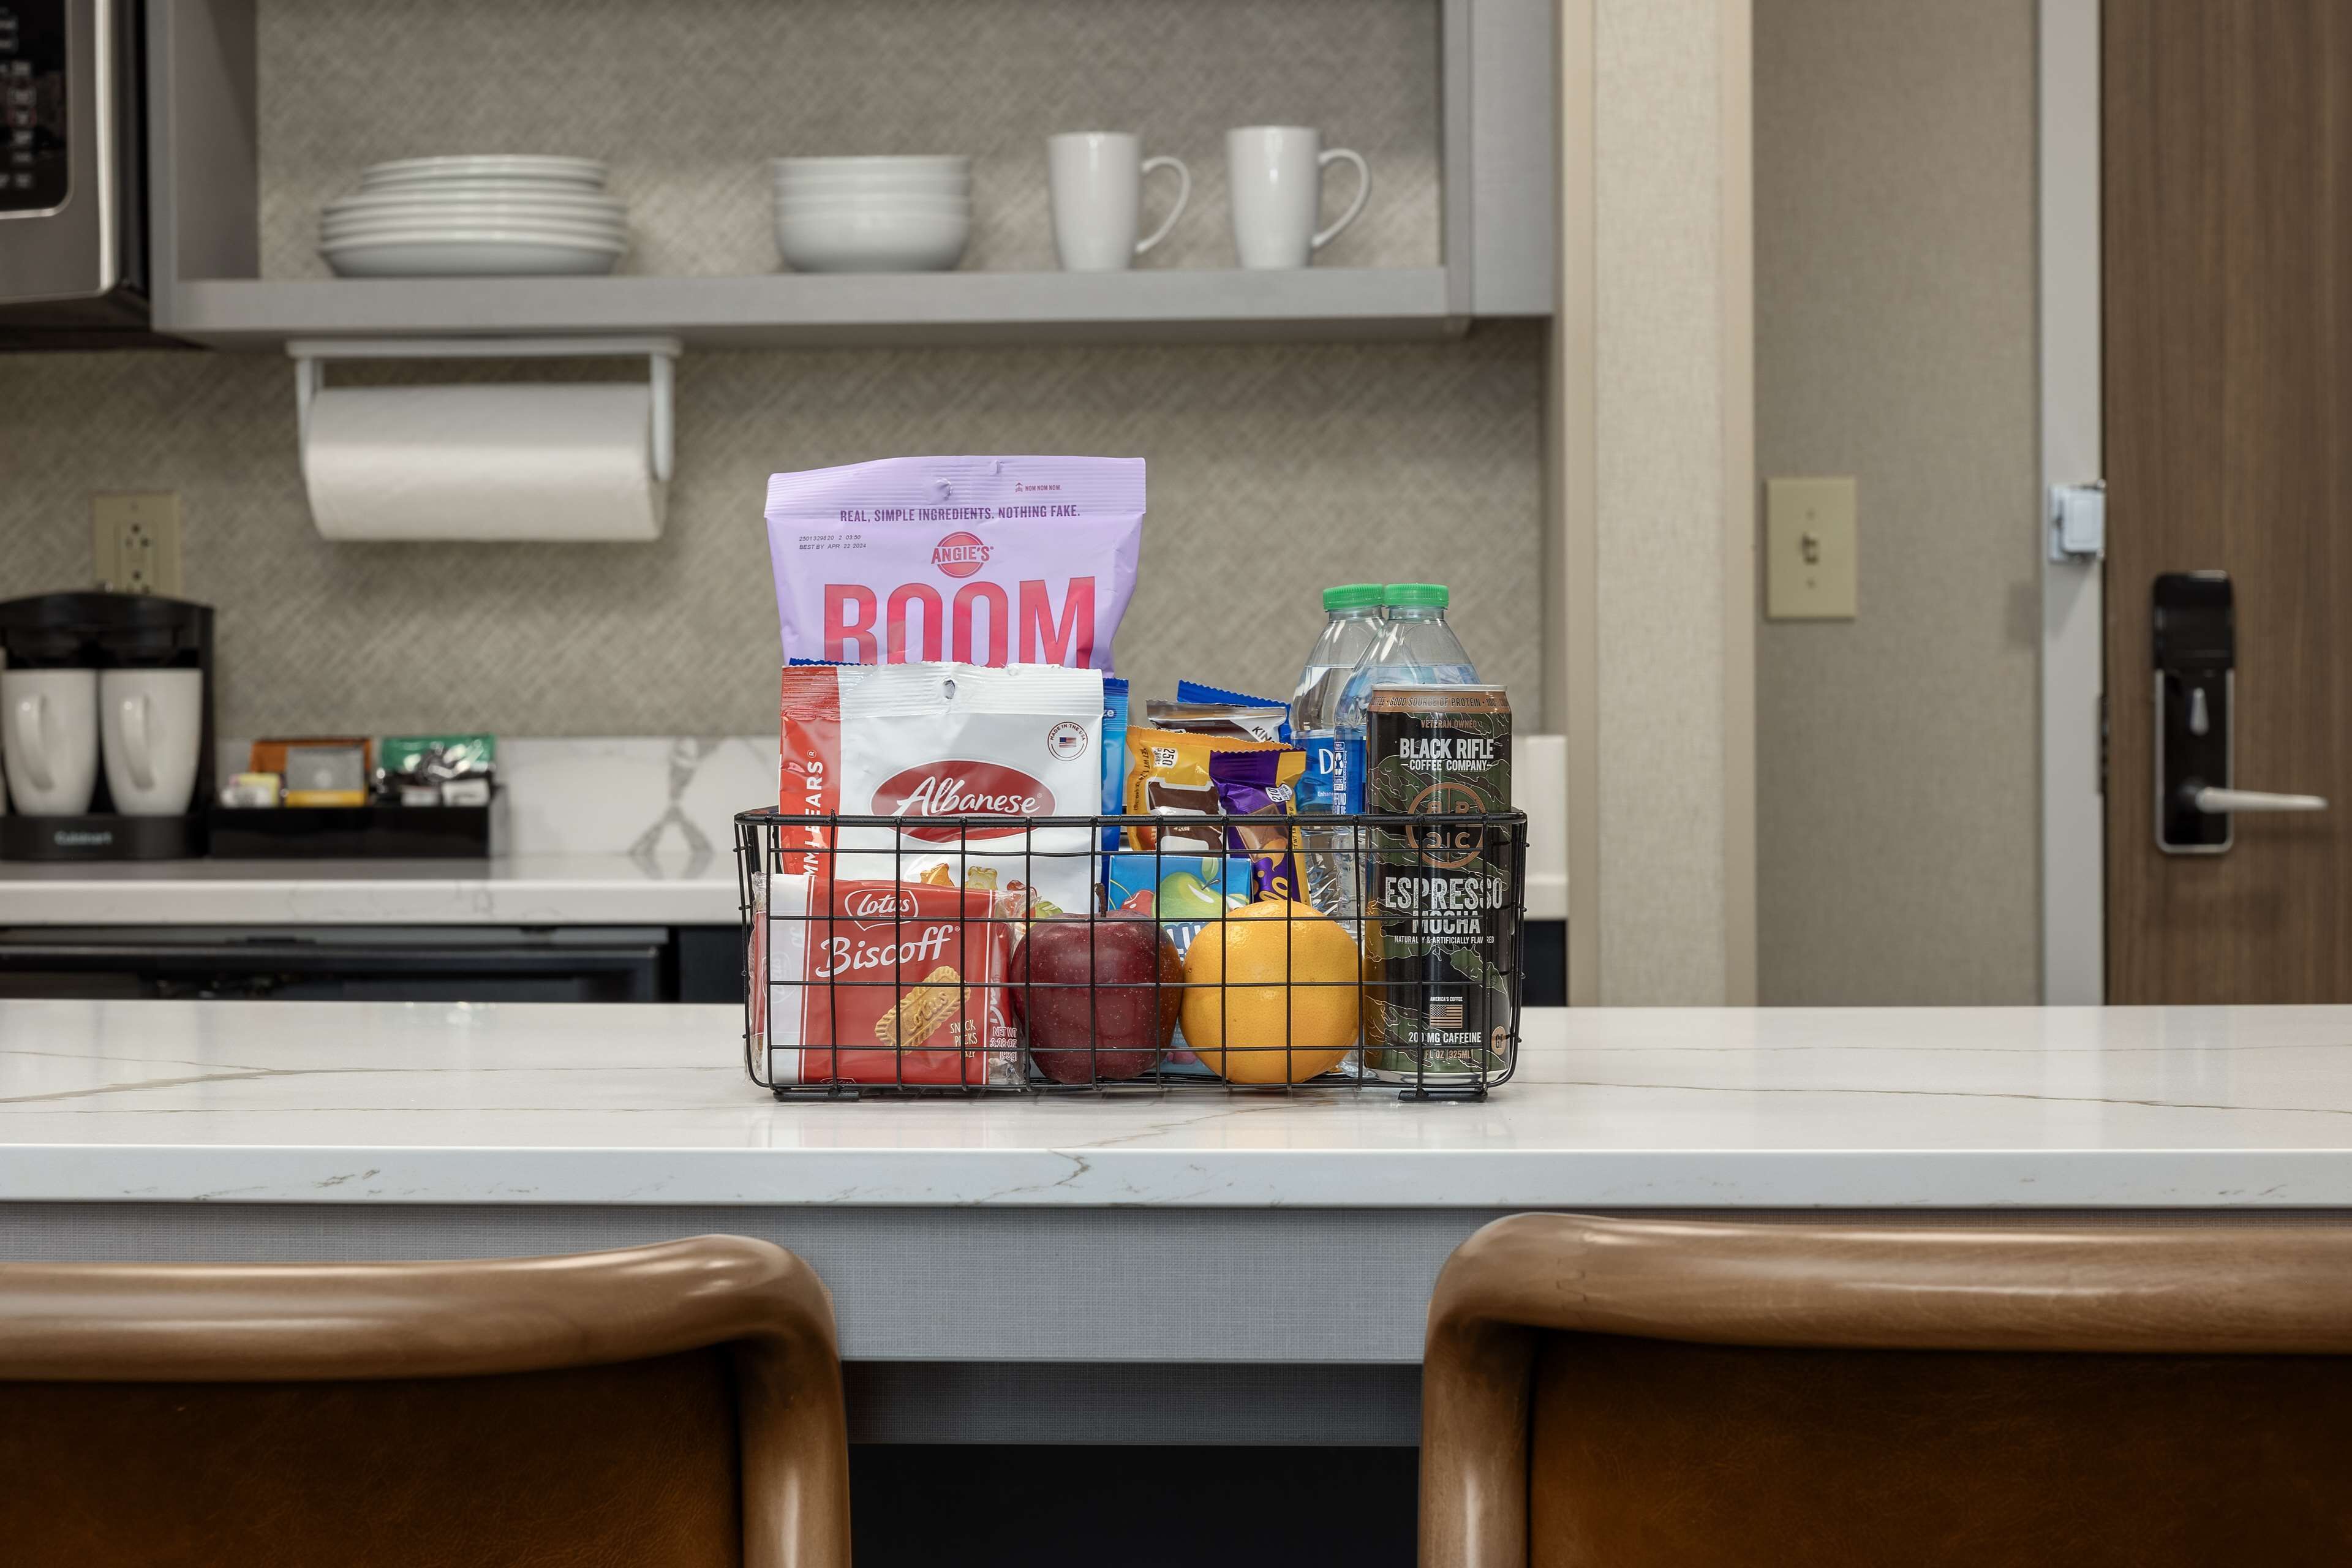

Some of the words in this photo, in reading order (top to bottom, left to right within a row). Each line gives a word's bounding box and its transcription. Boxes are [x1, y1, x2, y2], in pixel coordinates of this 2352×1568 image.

[840, 510, 871, 523] REAL,
[874, 509, 915, 522] SIMPLE
[919, 507, 995, 521] INGREDIENTS.
[998, 505, 1047, 518] NOTHING
[1050, 505, 1080, 518] FAKE.
[931, 546, 990, 565] ANGIE'S
[1389, 697, 1406, 706] GOOD
[1408, 698, 1437, 706] SOURCE
[1440, 698, 1449, 707] OF
[1452, 698, 1481, 707] PROTEIN
[1050, 726, 1061, 740] MADE
[1400, 738, 1452, 760] BLACK
[1457, 739, 1494, 760] RIFLE
[1162, 748, 1175, 766] 250
[1409, 760, 1442, 771] COFFEE
[1446, 760, 1488, 771] COMPANY
[893, 775, 1042, 817] Albanese
[1385, 877, 1502, 910] ESPRESSO
[857, 894, 911, 916] Lotus
[1412, 910, 1481, 934] MOCHA
[1395, 935, 1425, 944] NATURALY
[1432, 936, 1469, 944] ARTIFICIALLY
[1471, 935, 1494, 944] FLAVRED
[815, 924, 954, 978] Biscoff
[950, 1019, 976, 1034] SNCK
[992, 1027, 1006, 1037] NET
[1007, 1027, 1017, 1038] WT
[955, 1033, 978, 1047] PCKS
[990, 1038, 1006, 1048] 3.28
[1007, 1039, 1017, 1048] OZ
[1427, 1032, 1440, 1043] MG
[1443, 1032, 1482, 1042] CAFFEINE
[1425, 1050, 1434, 1059] FL
[1435, 1050, 1444, 1059] OZ
